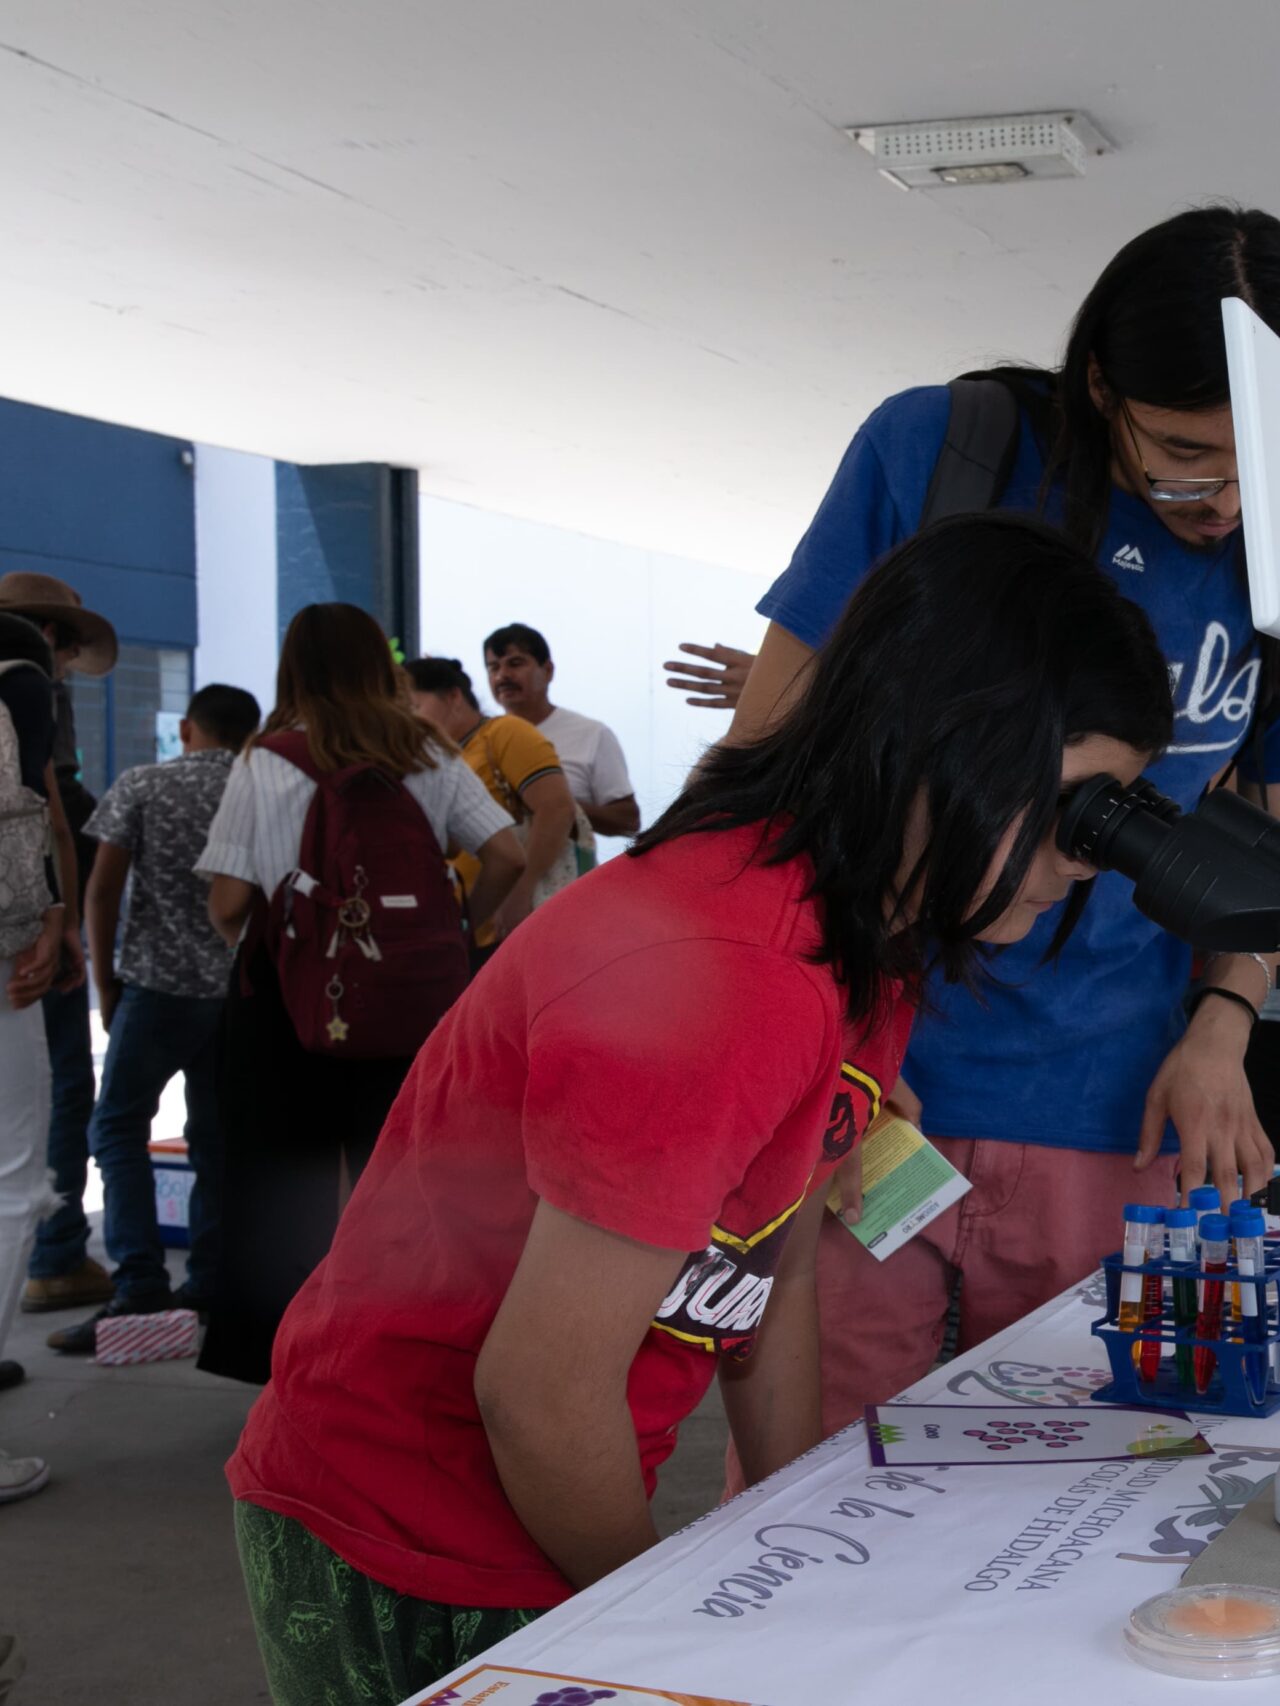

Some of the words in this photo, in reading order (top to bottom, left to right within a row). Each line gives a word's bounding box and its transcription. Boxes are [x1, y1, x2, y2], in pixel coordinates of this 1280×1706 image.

[1112, 556, 1145, 573] Majestic
[829, 1497, 916, 1519] la
[1042, 1496, 1087, 1516] DE
[963, 1517, 1070, 1593] HIDALGO
[1015, 1489, 1149, 1592] MICHOACANA
[692, 1522, 871, 1619] Ciencia
